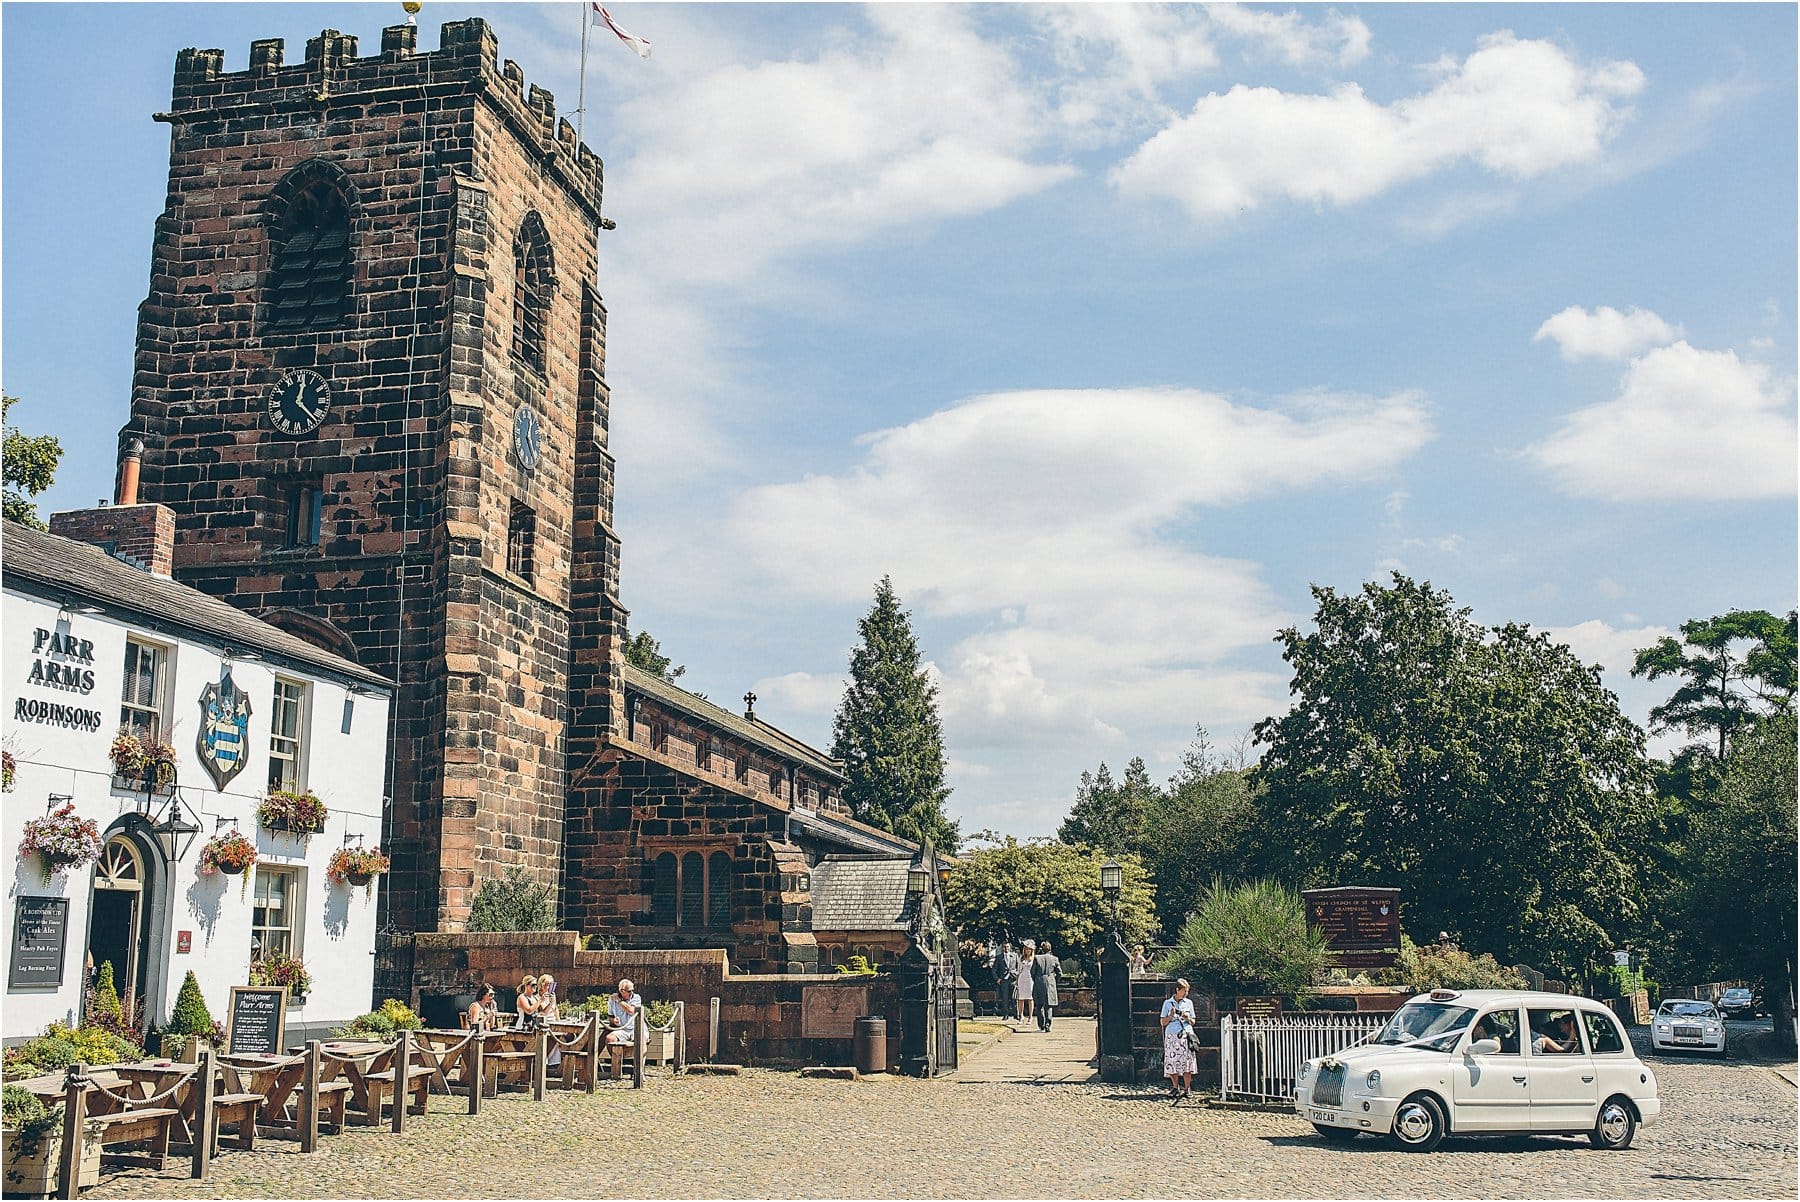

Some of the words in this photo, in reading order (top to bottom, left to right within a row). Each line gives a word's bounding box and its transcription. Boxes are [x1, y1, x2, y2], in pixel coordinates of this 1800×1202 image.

[33, 627, 95, 662] PARR
[27, 658, 95, 693] ARMS
[15, 697, 102, 730] ROBINSONS
[1323, 1113, 1335, 1122] CAB
